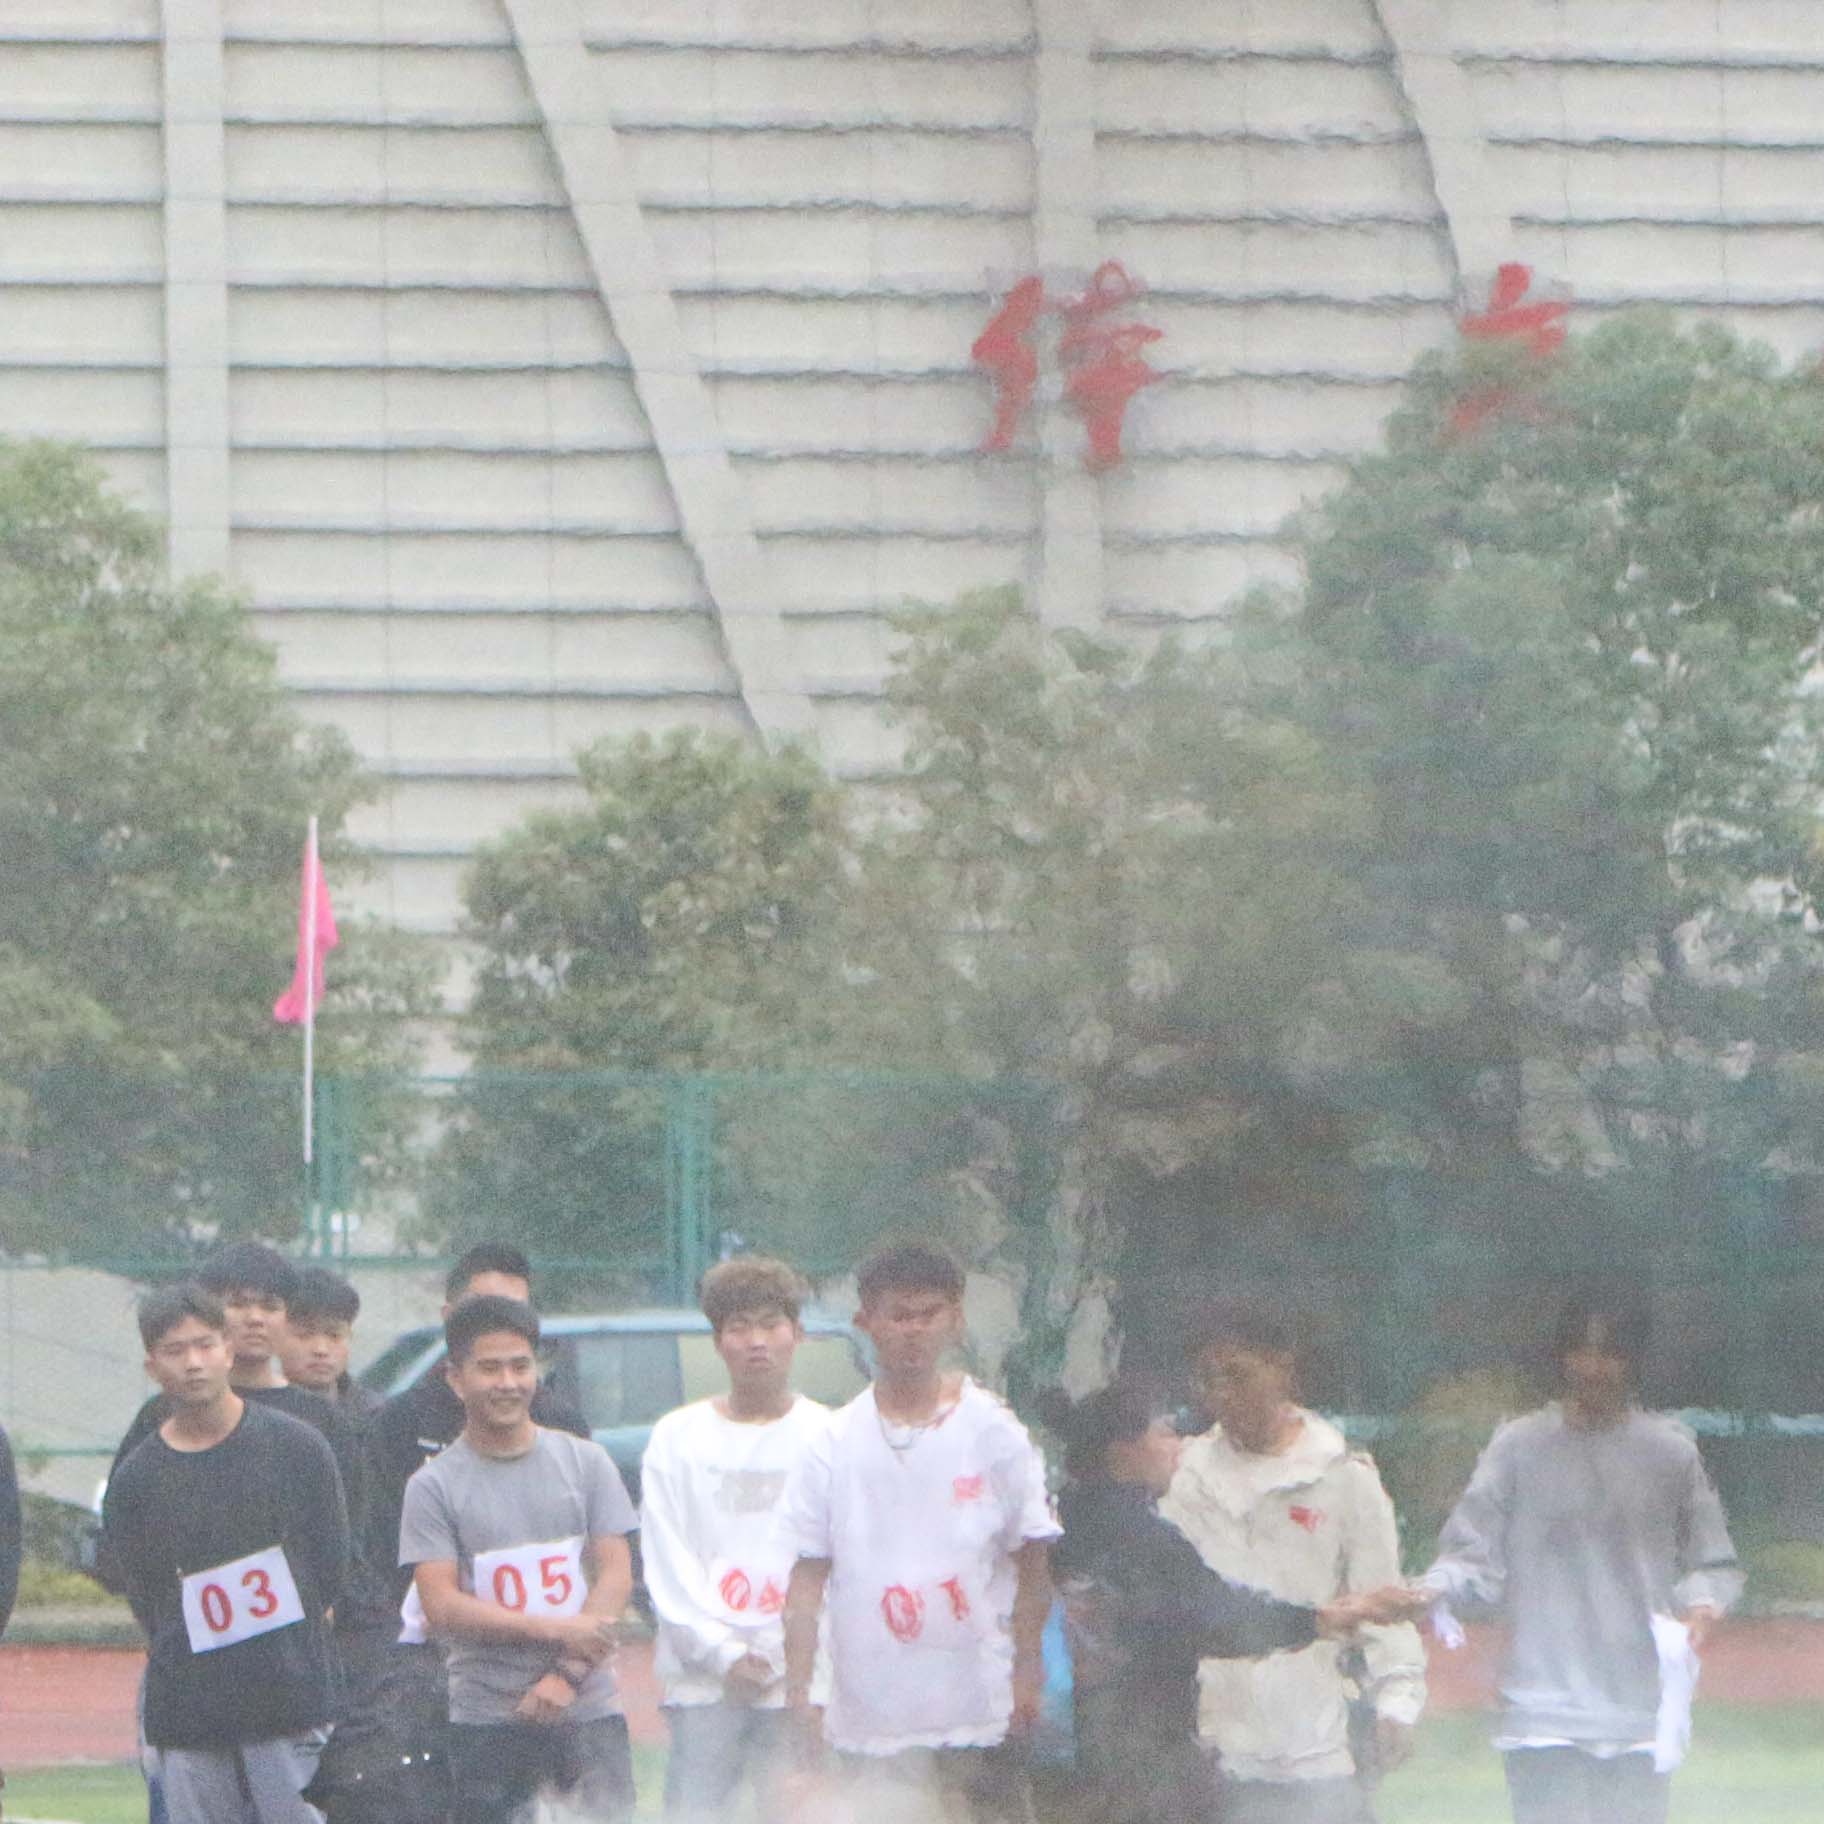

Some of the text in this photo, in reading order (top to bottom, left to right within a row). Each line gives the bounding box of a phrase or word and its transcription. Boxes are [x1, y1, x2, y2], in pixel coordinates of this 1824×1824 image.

[200, 1568, 279, 1633] 03
[493, 1555, 572, 1612] 05
[880, 1576, 970, 1641] 01
